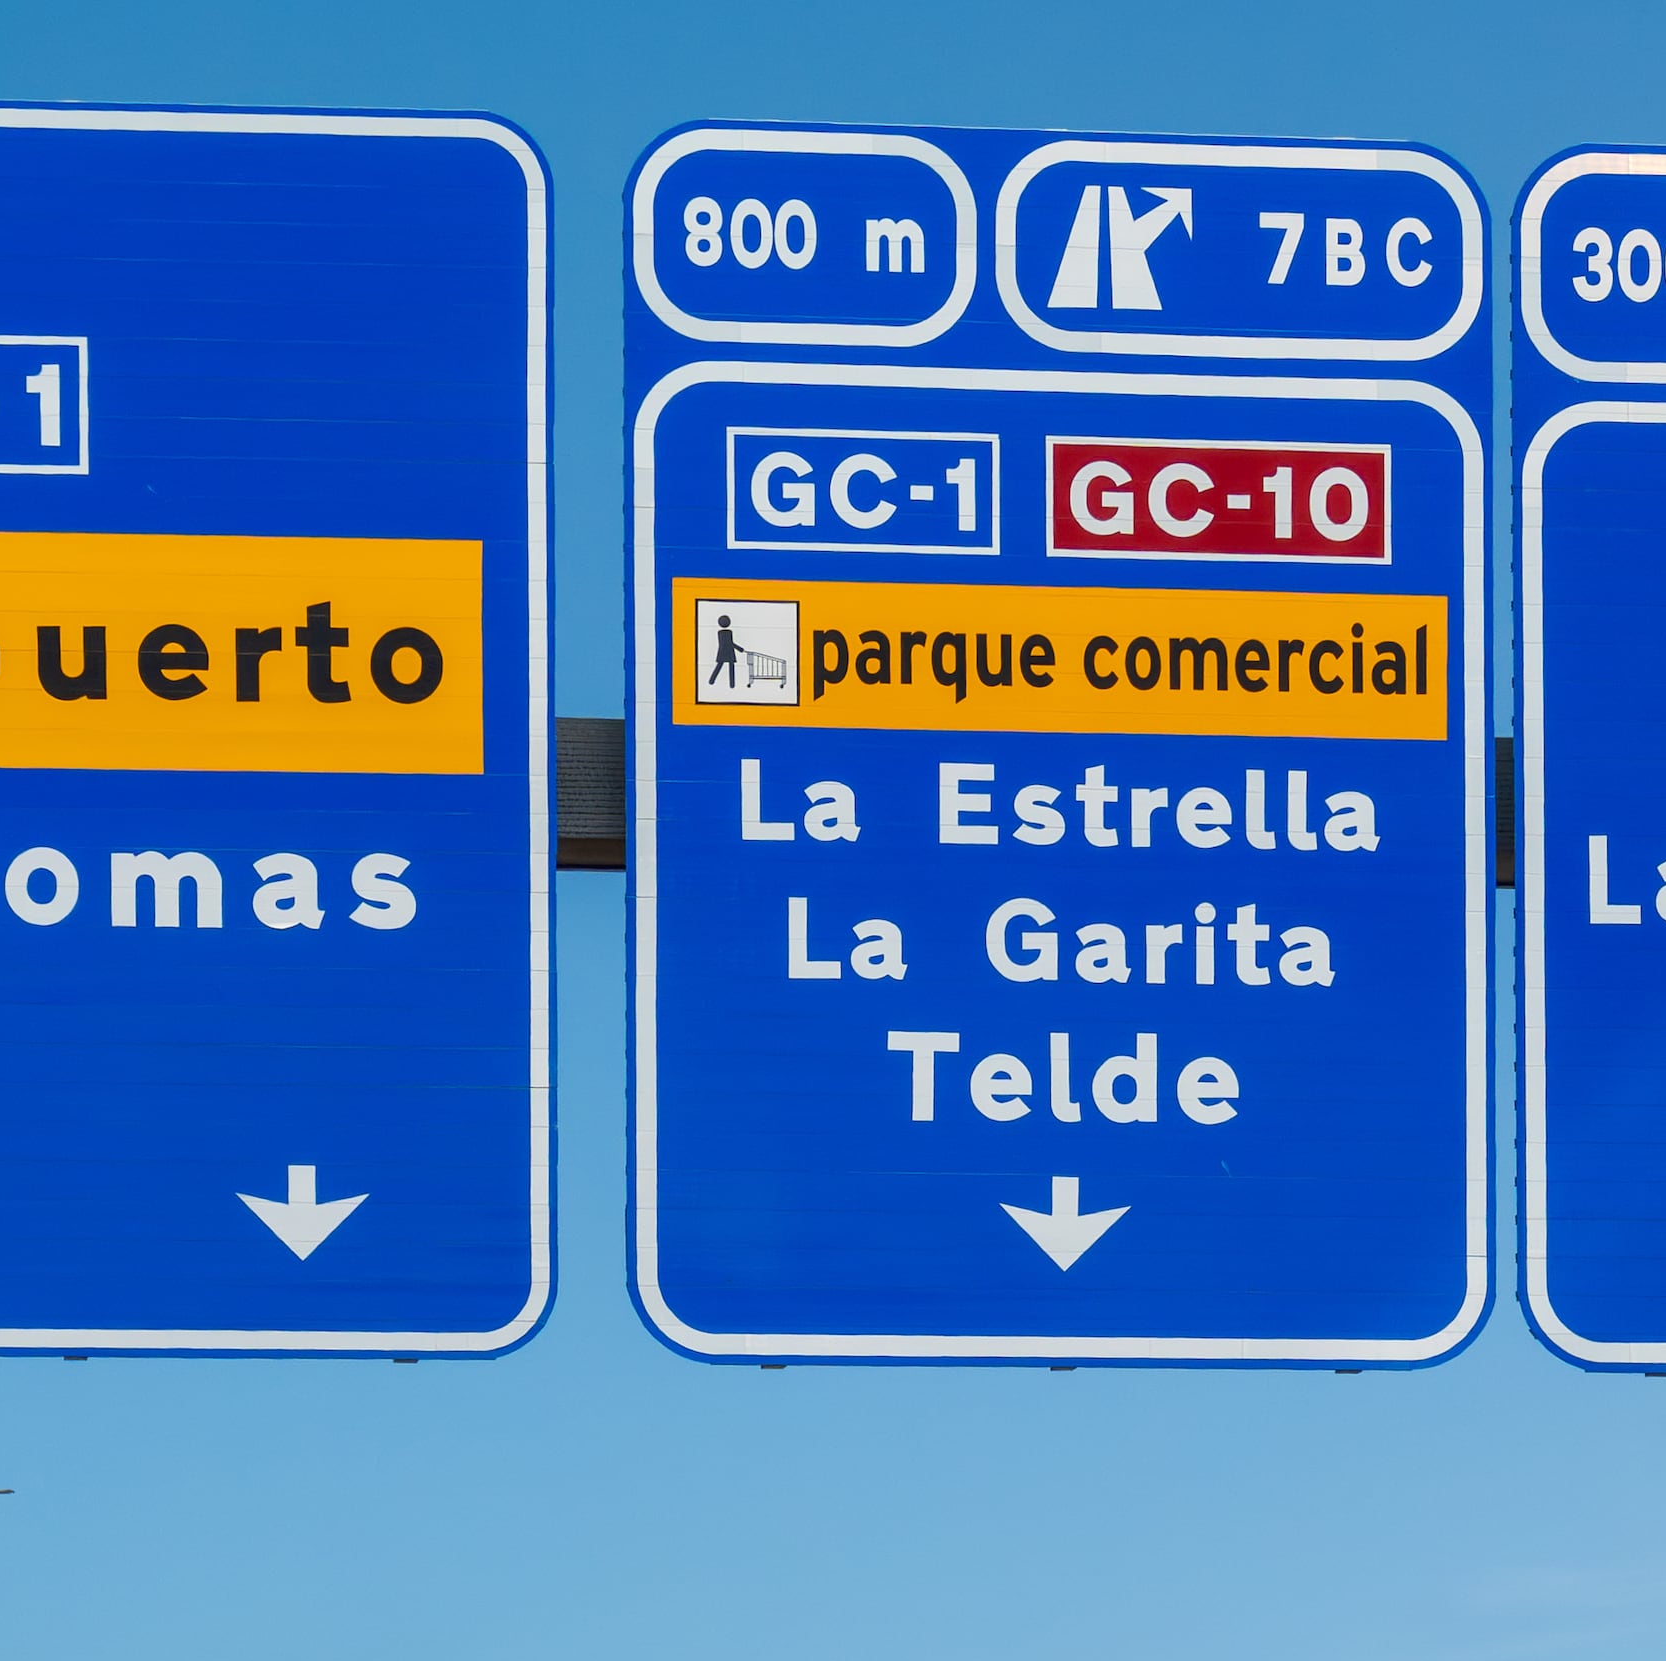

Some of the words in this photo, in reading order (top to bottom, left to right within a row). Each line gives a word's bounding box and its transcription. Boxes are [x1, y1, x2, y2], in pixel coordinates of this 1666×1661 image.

[683, 196, 817, 270] 800
[865, 217, 925, 273] m
[750, 451, 976, 532] GC-1
[1069, 460, 1370, 542] GC-10
[813, 629, 1057, 704] parque
[1083, 622, 1428, 695] comercial
[740, 758, 861, 842] La
[938, 762, 1381, 852] Estrella
[787, 896, 908, 981] La
[985, 897, 1336, 987] Garita
[887, 1030, 1240, 1125] Telde
